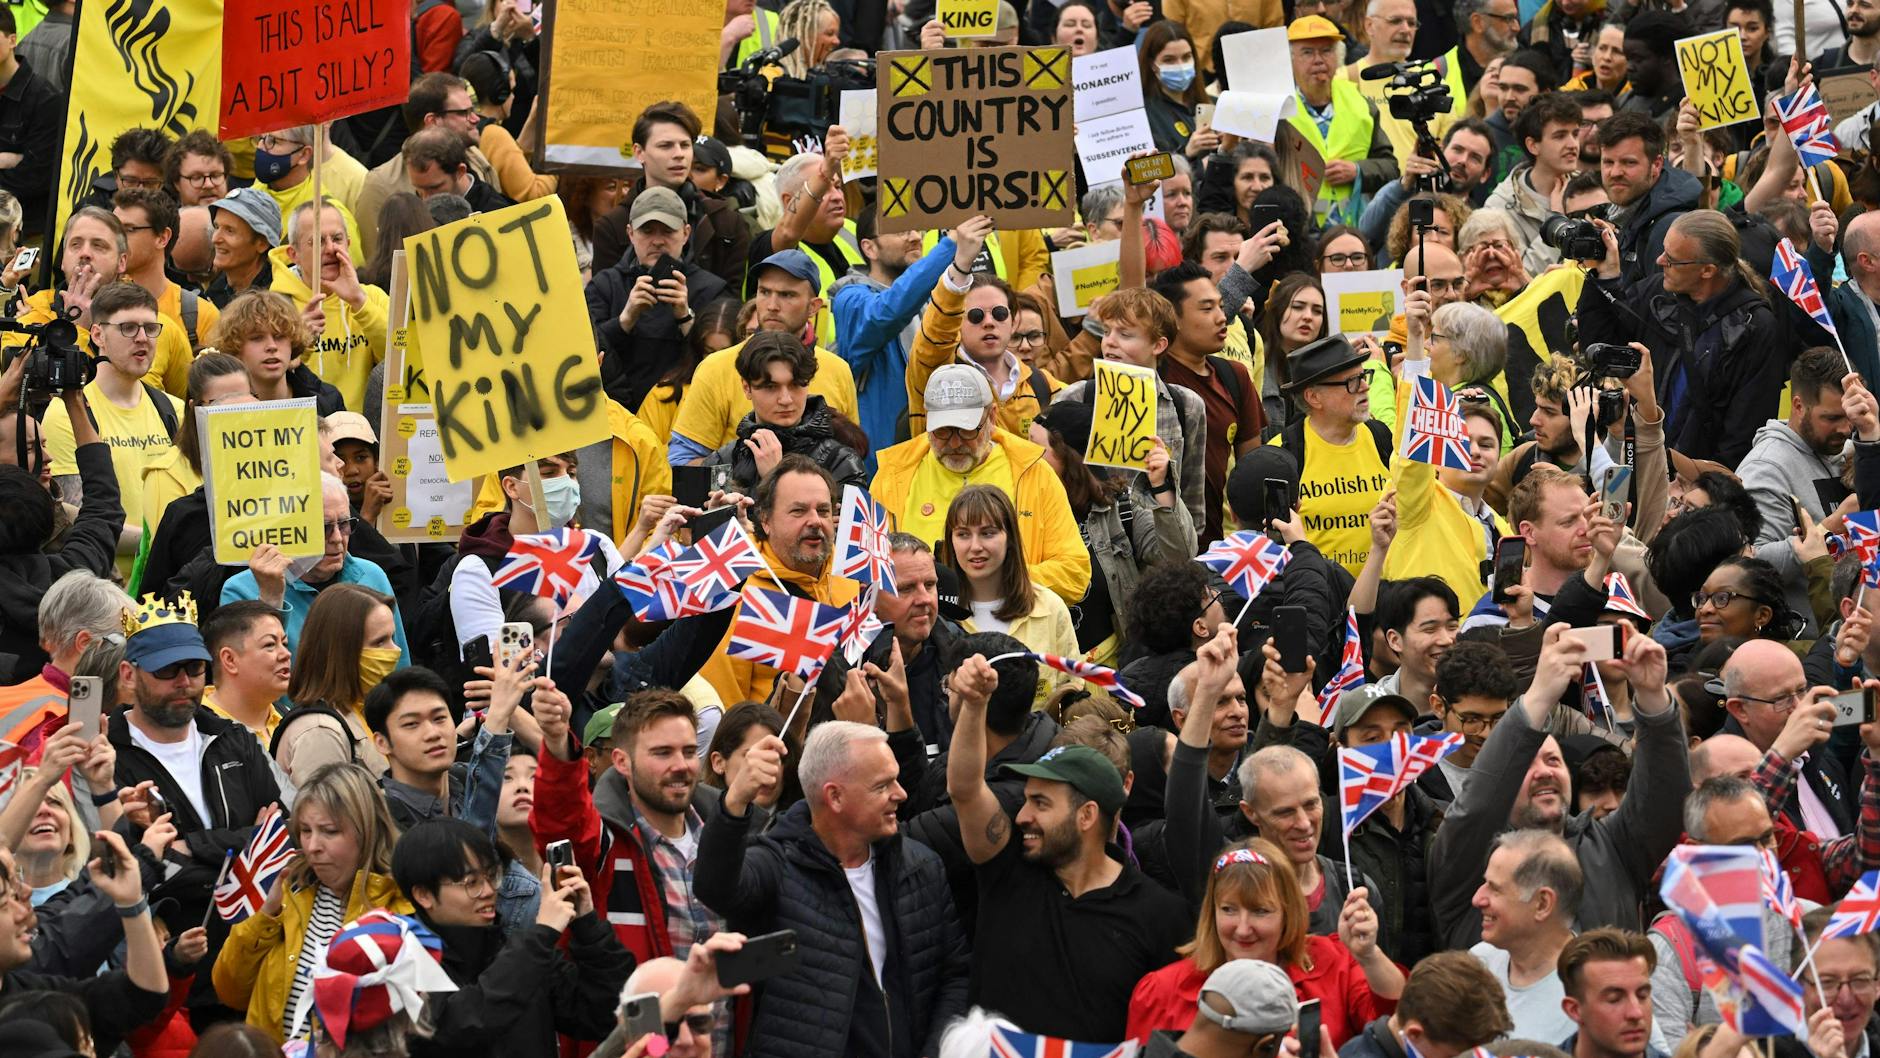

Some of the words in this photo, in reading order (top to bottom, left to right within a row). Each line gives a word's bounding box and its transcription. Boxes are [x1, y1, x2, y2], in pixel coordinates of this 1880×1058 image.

[255, 9, 303, 53] THIS
[315, 4, 334, 44] IS
[339, 0, 384, 38] ALL
[942, 10, 993, 28] KING
[1680, 33, 1736, 72] NOT
[933, 52, 1021, 90] THIS
[1696, 63, 1736, 98] MY
[229, 82, 250, 116] A
[258, 68, 303, 112] BIT
[1693, 90, 1752, 127] KING
[887, 94, 1068, 141] COUNTRY
[967, 135, 998, 170] IS
[1133, 160, 1151, 170] NOT
[1152, 158, 1165, 167] MY
[1142, 168, 1161, 178] KING
[914, 170, 1040, 214] OURS!
[414, 203, 552, 323] NOT
[1075, 277, 1118, 291] #NotMyKing
[1340, 306, 1383, 317] #NotMyKing
[449, 301, 541, 369] MY
[1098, 367, 1153, 403] NOT
[1105, 396, 1148, 436] MY
[1415, 405, 1464, 443] HELLO!
[222, 428, 268, 450] NOT
[274, 426, 305, 446] MY
[1090, 431, 1151, 463] KING
[236, 458, 297, 481] KING,
[1299, 475, 1368, 500] Abolish
[1372, 473, 1387, 492] th
[227, 496, 272, 518] NOT
[279, 494, 310, 514] MY
[1304, 513, 1369, 531] Monar
[232, 525, 308, 549] QUEEN
